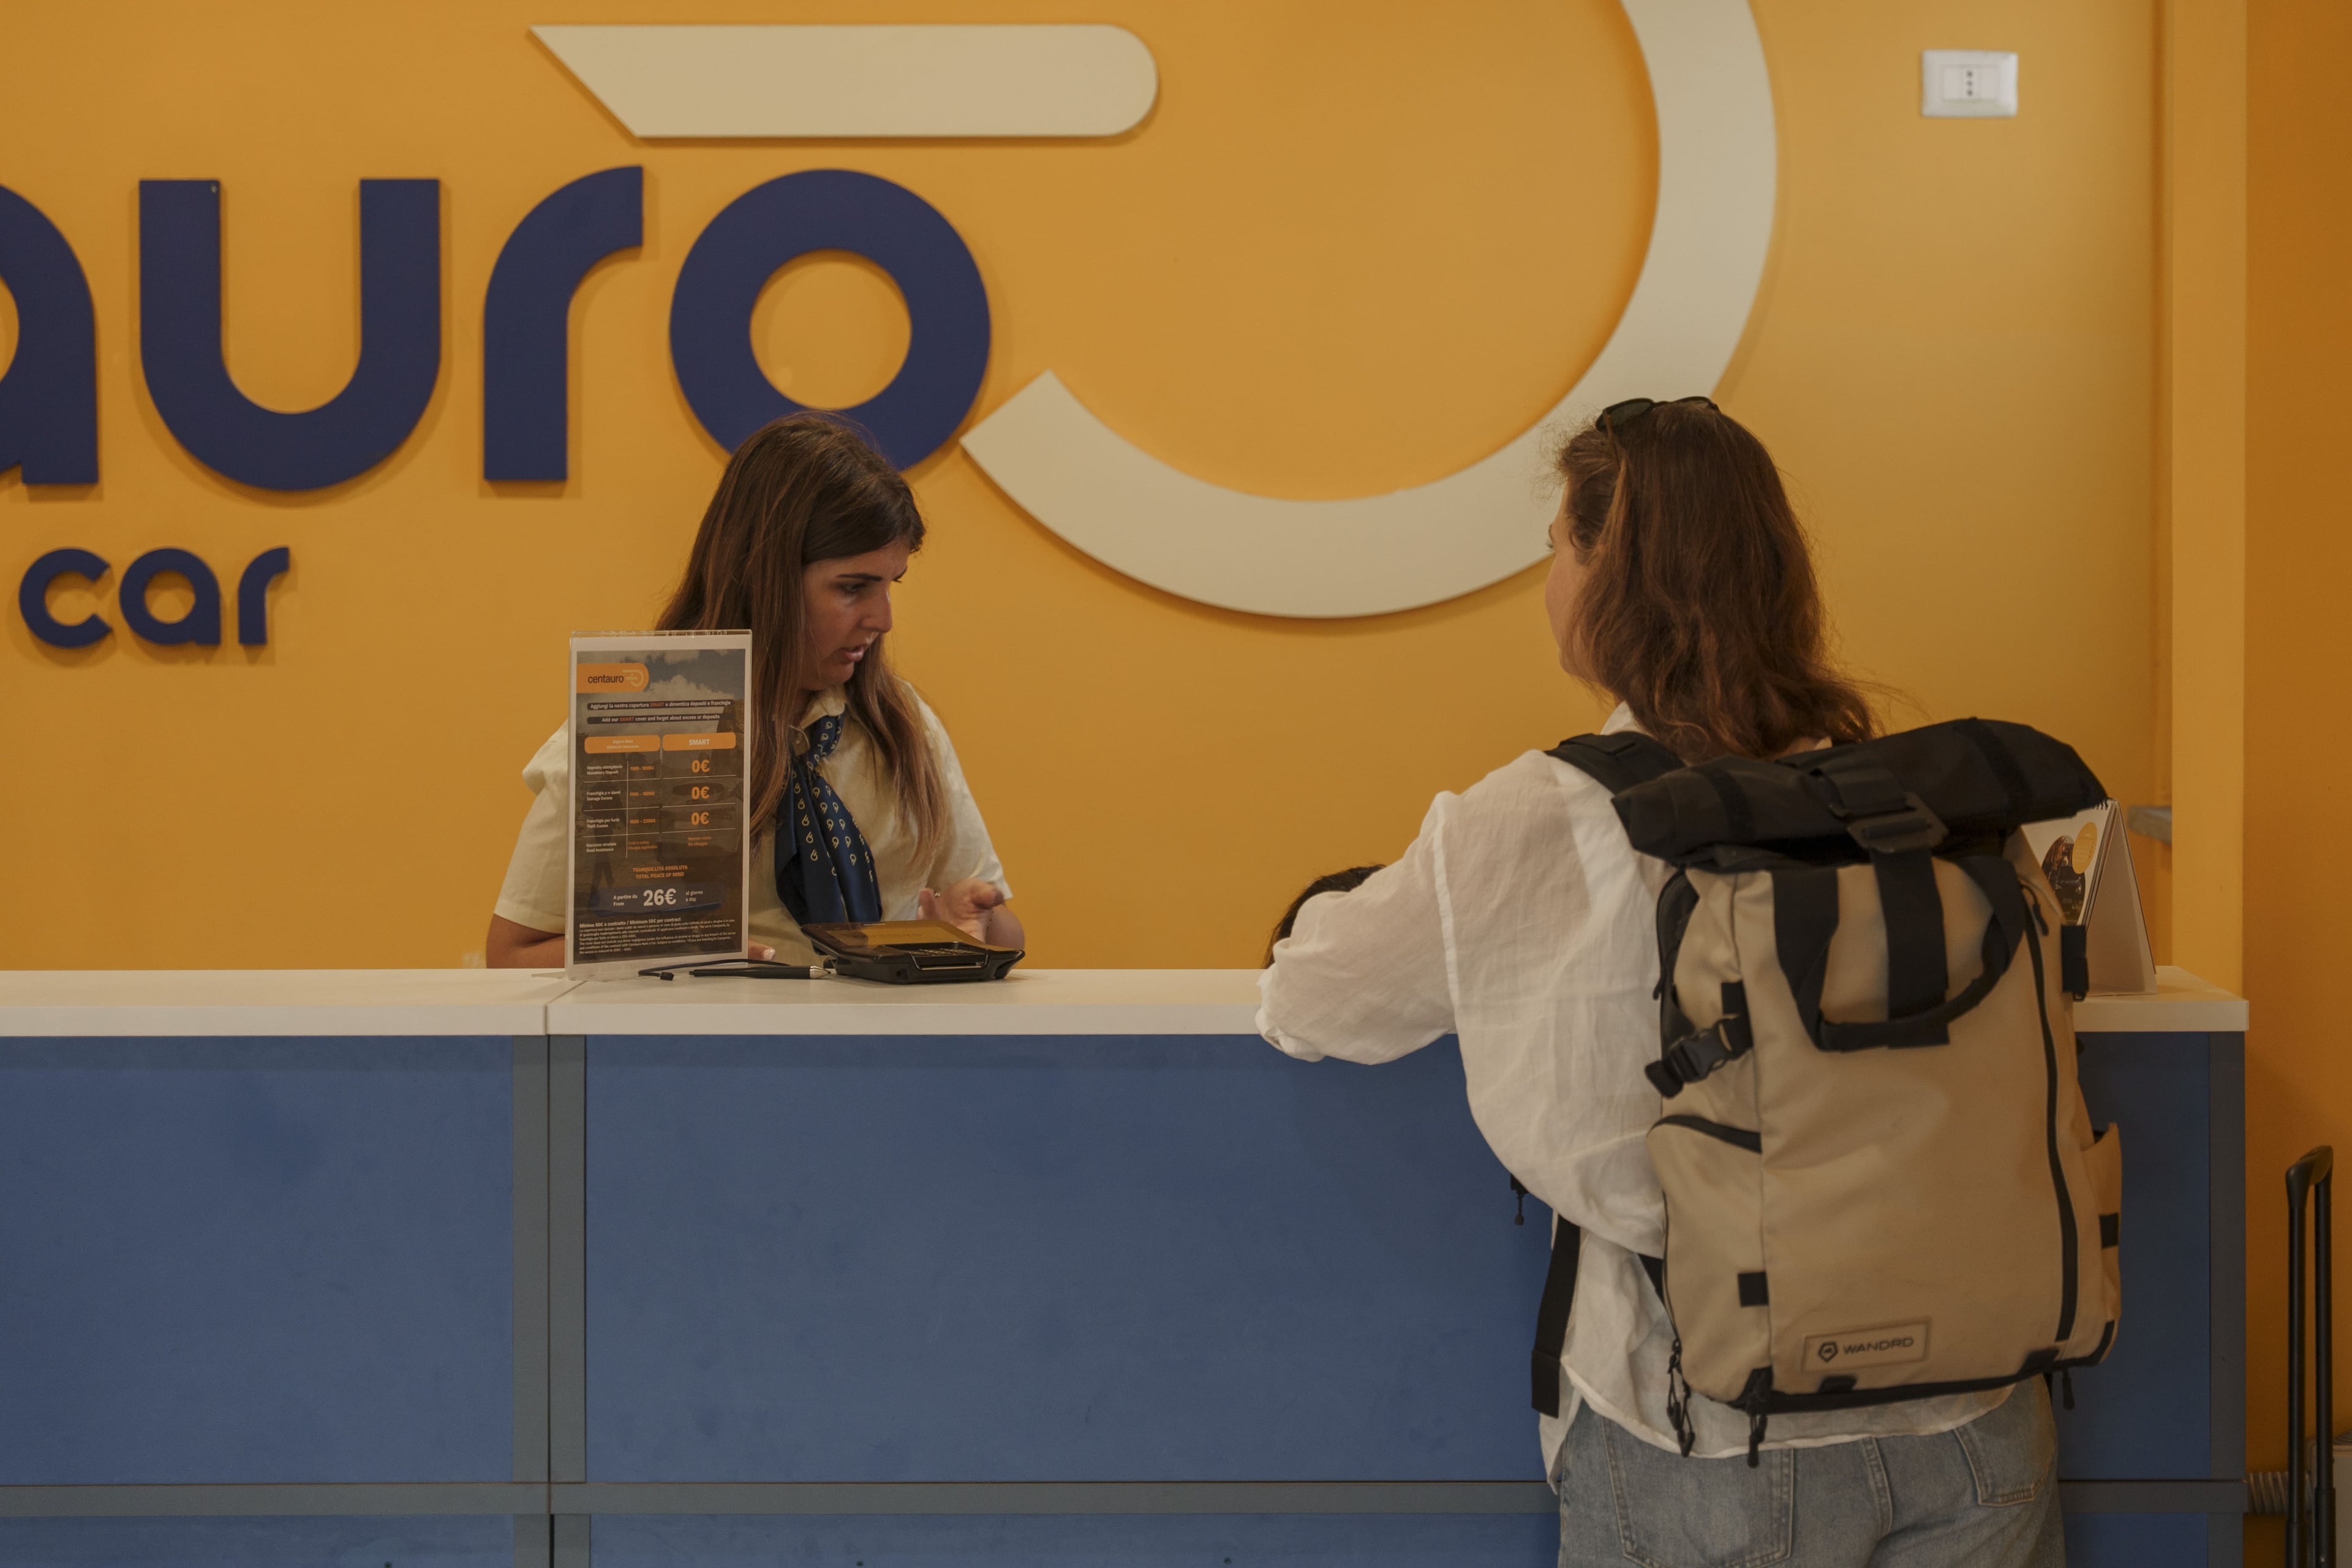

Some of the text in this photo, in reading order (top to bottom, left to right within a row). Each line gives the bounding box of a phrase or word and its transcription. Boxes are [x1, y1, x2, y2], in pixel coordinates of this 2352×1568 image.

[19, 546, 290, 649] car
[588, 674, 624, 684] centauro
[691, 760, 710, 773] 0€
[691, 786, 709, 799] 0€
[691, 812, 709, 825] 0€
[643, 888, 676, 907] 26€
[1844, 1337, 1914, 1354] WANDRD
